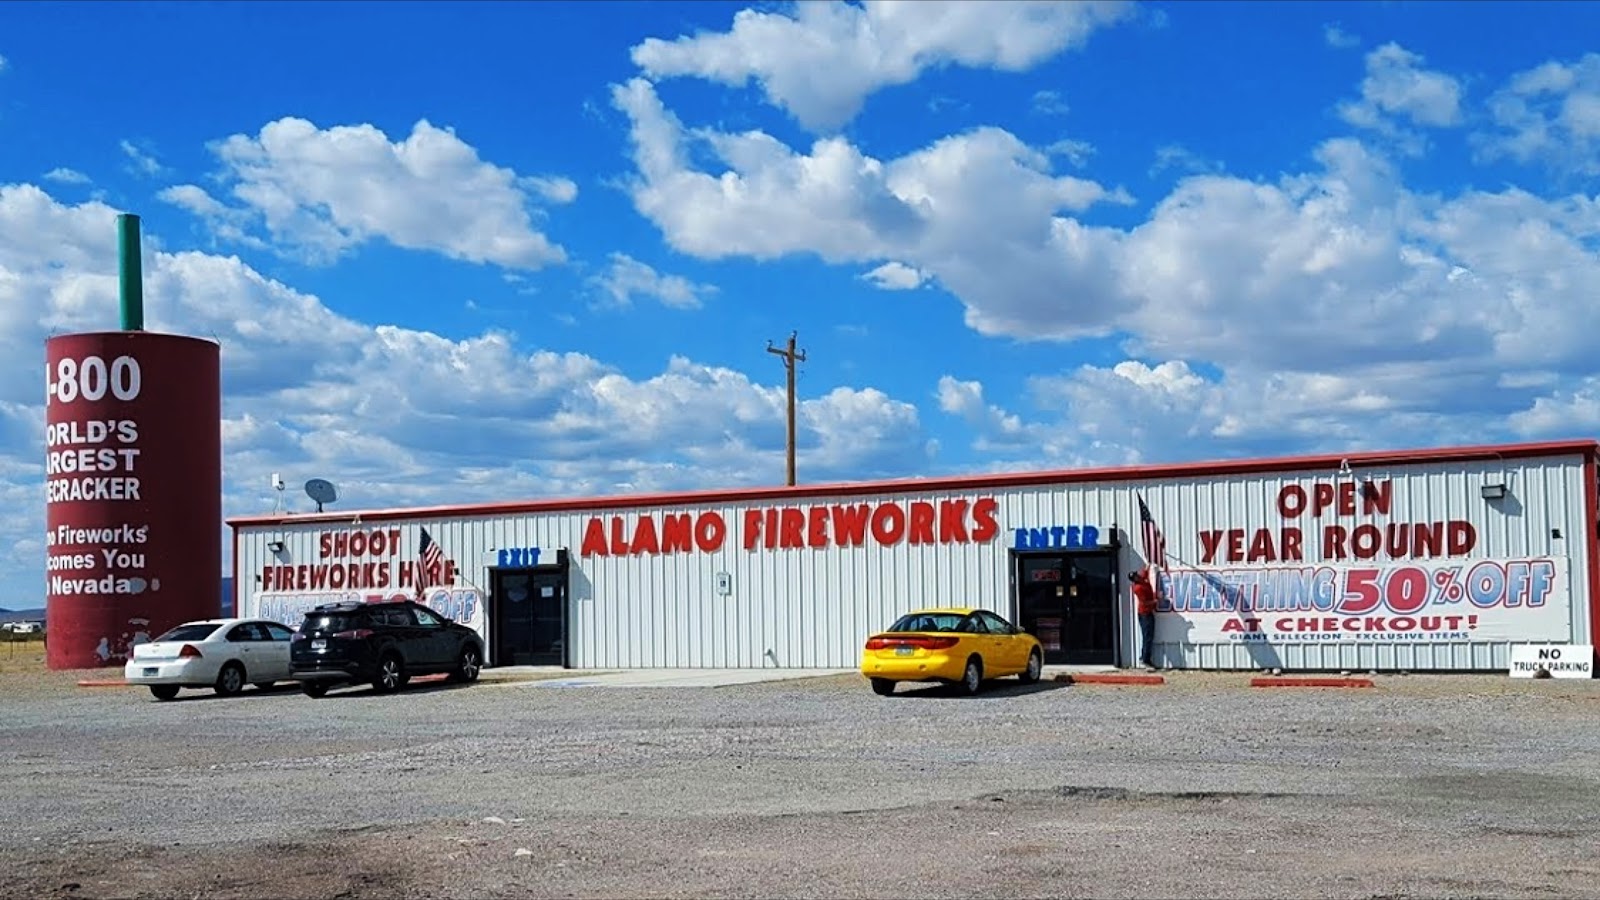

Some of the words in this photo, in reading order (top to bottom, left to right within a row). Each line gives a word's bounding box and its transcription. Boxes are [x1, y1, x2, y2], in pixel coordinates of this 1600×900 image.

[47, 420, 138, 447] ORLD'S
[47, 448, 140, 475] RGEST
[47, 477, 140, 504] ECRACKER
[1277, 480, 1391, 519] OPEN
[58, 523, 148, 545] Fireworks
[581, 511, 726, 557] ALAMO
[744, 498, 999, 551] FIREWORKS
[1015, 525, 1099, 550] ENTER
[319, 529, 401, 559] SHOOT
[1198, 527, 1303, 563] YEAR
[1323, 520, 1477, 560] ROUND
[47, 552, 95, 570] comes
[101, 548, 145, 569] You
[498, 547, 541, 570] EXIT
[52, 574, 131, 596] Nevada
[263, 562, 390, 592] FIREWORKS
[399, 559, 455, 589] HRE
[1155, 566, 1336, 613] EVERYTHING
[1334, 564, 1464, 615] 50%
[1466, 560, 1555, 608] OFF
[1221, 618, 1262, 632] AT
[1275, 615, 1479, 632] CHECKOUT!
[1229, 633, 1267, 641] GIANT
[1273, 633, 1341, 641] SELECTION
[1356, 632, 1424, 640] EXCLUSIVE
[1430, 631, 1469, 640] ITEMS
[1538, 648, 1561, 660] NO
[1548, 661, 1590, 672] PARKING
